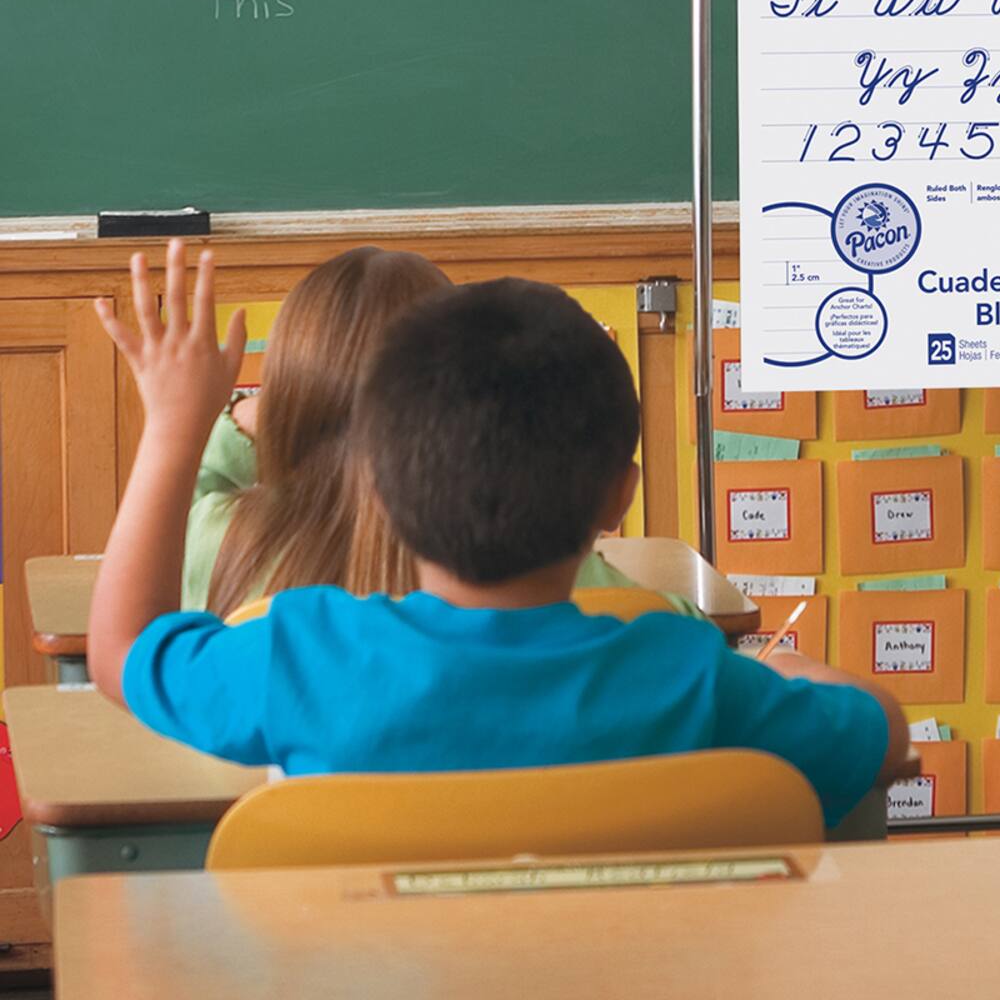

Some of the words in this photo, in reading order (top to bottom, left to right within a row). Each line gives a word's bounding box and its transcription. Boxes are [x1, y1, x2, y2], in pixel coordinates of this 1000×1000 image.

[857, 51, 939, 106] Yy
[828, 123, 861, 162] 2
[871, 123, 902, 161] 3
[919, 123, 949, 161] 4
[959, 122, 1000, 160] 5
[949, 184, 967, 192] Both
[926, 194, 946, 202] Sides
[844, 225, 908, 258] Pacon
[791, 274, 806, 282] 2.5
[959, 339, 987, 349] Sheets
[931, 340, 952, 361] 25
[959, 350, 982, 361] Hojas
[887, 509, 914, 519] Drew
[885, 641, 926, 654] Anthony
